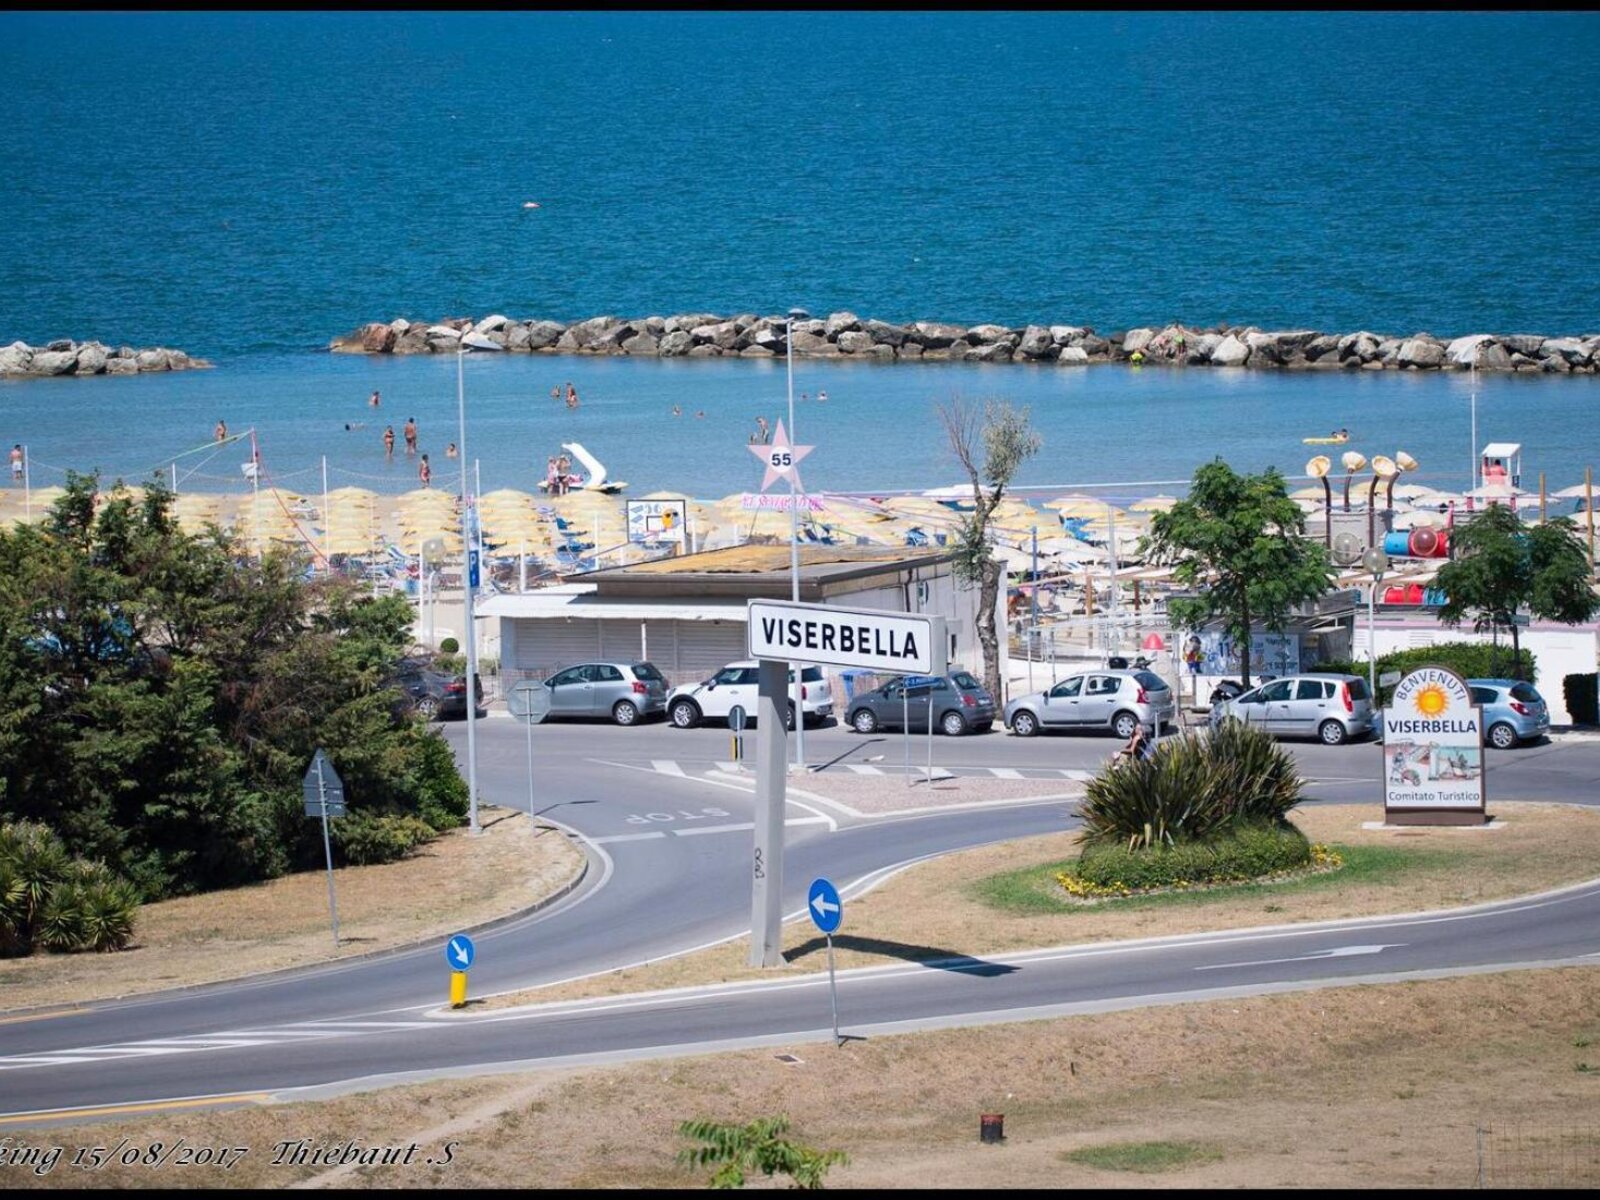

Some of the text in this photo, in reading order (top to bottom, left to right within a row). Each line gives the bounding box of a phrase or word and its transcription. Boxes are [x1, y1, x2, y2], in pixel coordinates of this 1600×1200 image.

[771, 453, 791, 466] 55
[762, 616, 919, 660] VISERBELLA
[1396, 670, 1466, 701] BENVENUTI
[1388, 719, 1477, 733] VISERBELLA
[1388, 791, 1480, 801] Comitato Turistico
